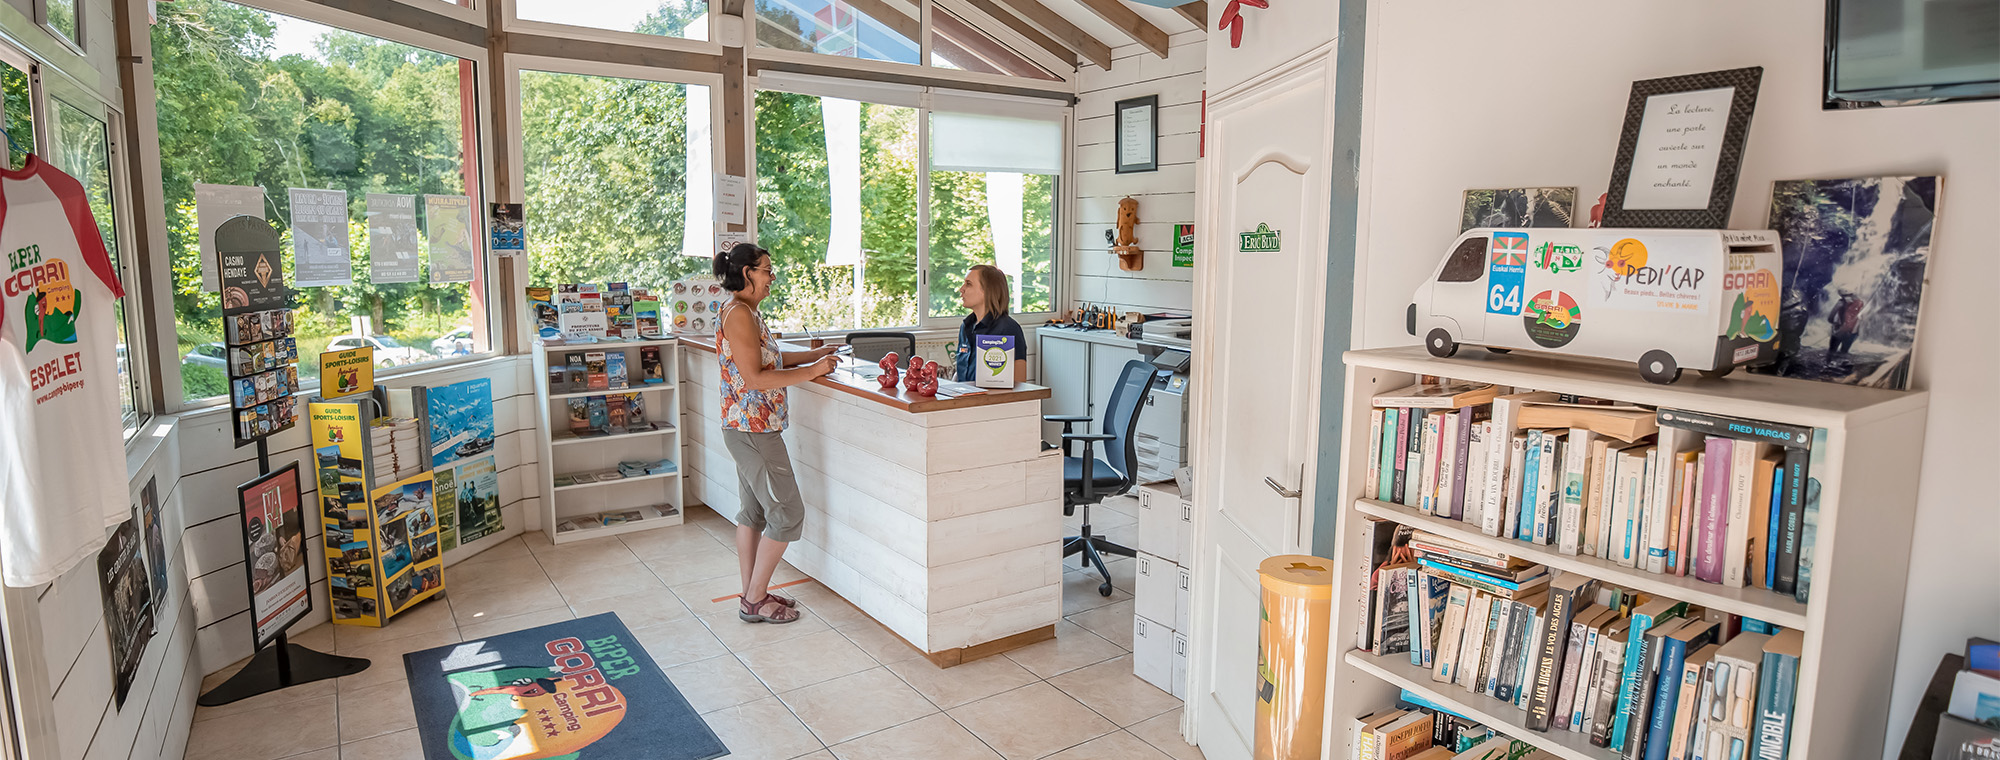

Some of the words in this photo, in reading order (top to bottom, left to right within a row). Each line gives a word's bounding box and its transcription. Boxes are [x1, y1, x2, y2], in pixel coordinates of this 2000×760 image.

[1667, 104, 1680, 115] La
[1683, 124, 1706, 136] porte
[1659, 143, 1687, 151] ouverte
[1671, 161, 1697, 169] monde
[224, 256, 244, 266] CASINO
[1492, 265, 1508, 273] Euskal
[4, 261, 66, 298] GORRI
[224, 267, 247, 278] HENDAYE
[1625, 264, 1704, 290] PEDI'CAP
[1723, 272, 1769, 290] GORRI
[1490, 284, 1520, 312] 64
[1534, 304, 1563, 312] GORRI
[325, 356, 369, 369] SPORTS-LOISIRS
[338, 351, 356, 359] GUIDE
[30, 352, 83, 392] ESPELET
[1729, 423, 1753, 435] FRED
[1754, 427, 1791, 441] VARGAS
[435, 479, 454, 492] anoë
[1737, 474, 1745, 492] TOUT
[1792, 478, 1799, 487] UN
[1488, 496, 1496, 506] LE
[1790, 488, 1798, 505] SANS
[1786, 512, 1796, 531] COBEN
[1705, 531, 1714, 554] douleur
[1785, 532, 1795, 553] HARLAN
[1552, 594, 1563, 617] AIGLES
[1549, 618, 1559, 632] DES
[1548, 632, 1556, 645] VOL
[1546, 645, 1553, 655] LE
[545, 636, 626, 718] GORRI
[1537, 657, 1553, 686] HIGGINS
[1535, 686, 1547, 703] JACK
[1653, 720, 1662, 730] Les
[1661, 675, 1671, 692] Rhône
[553, 692, 582, 733] Camping
[1390, 727, 1413, 745] JOSEPH
[1413, 720, 1431, 735] JOFFO
[1961, 742, 1974, 753] LA
